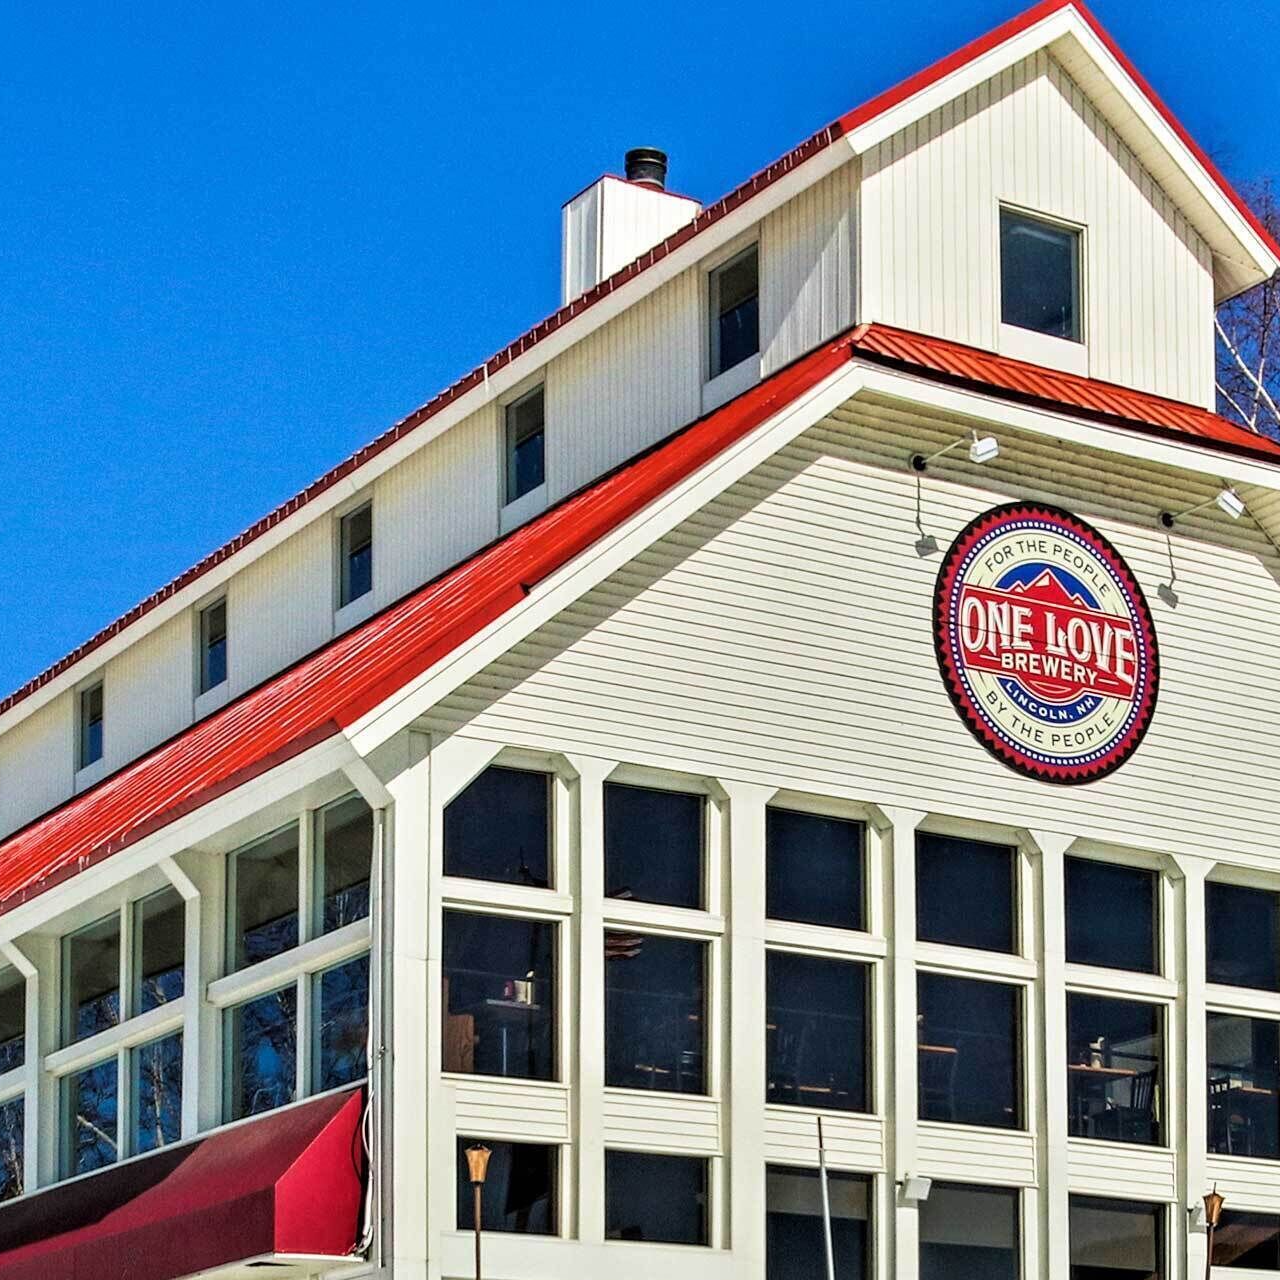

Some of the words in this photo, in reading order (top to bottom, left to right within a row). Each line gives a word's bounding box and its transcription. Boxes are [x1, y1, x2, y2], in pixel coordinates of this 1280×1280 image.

[985, 545, 1015, 573] FOR
[1016, 541, 1048, 554] THE
[1053, 544, 1111, 598] PEOPLE
[963, 597, 1034, 658] ONE
[1044, 611, 1137, 685] LOVE
[1001, 653, 1098, 685] BREWERY
[986, 690, 1007, 715] BY
[1012, 714, 1044, 743] THE
[1052, 713, 1115, 747] PEOPLE
[1077, 697, 1095, 715] NH
